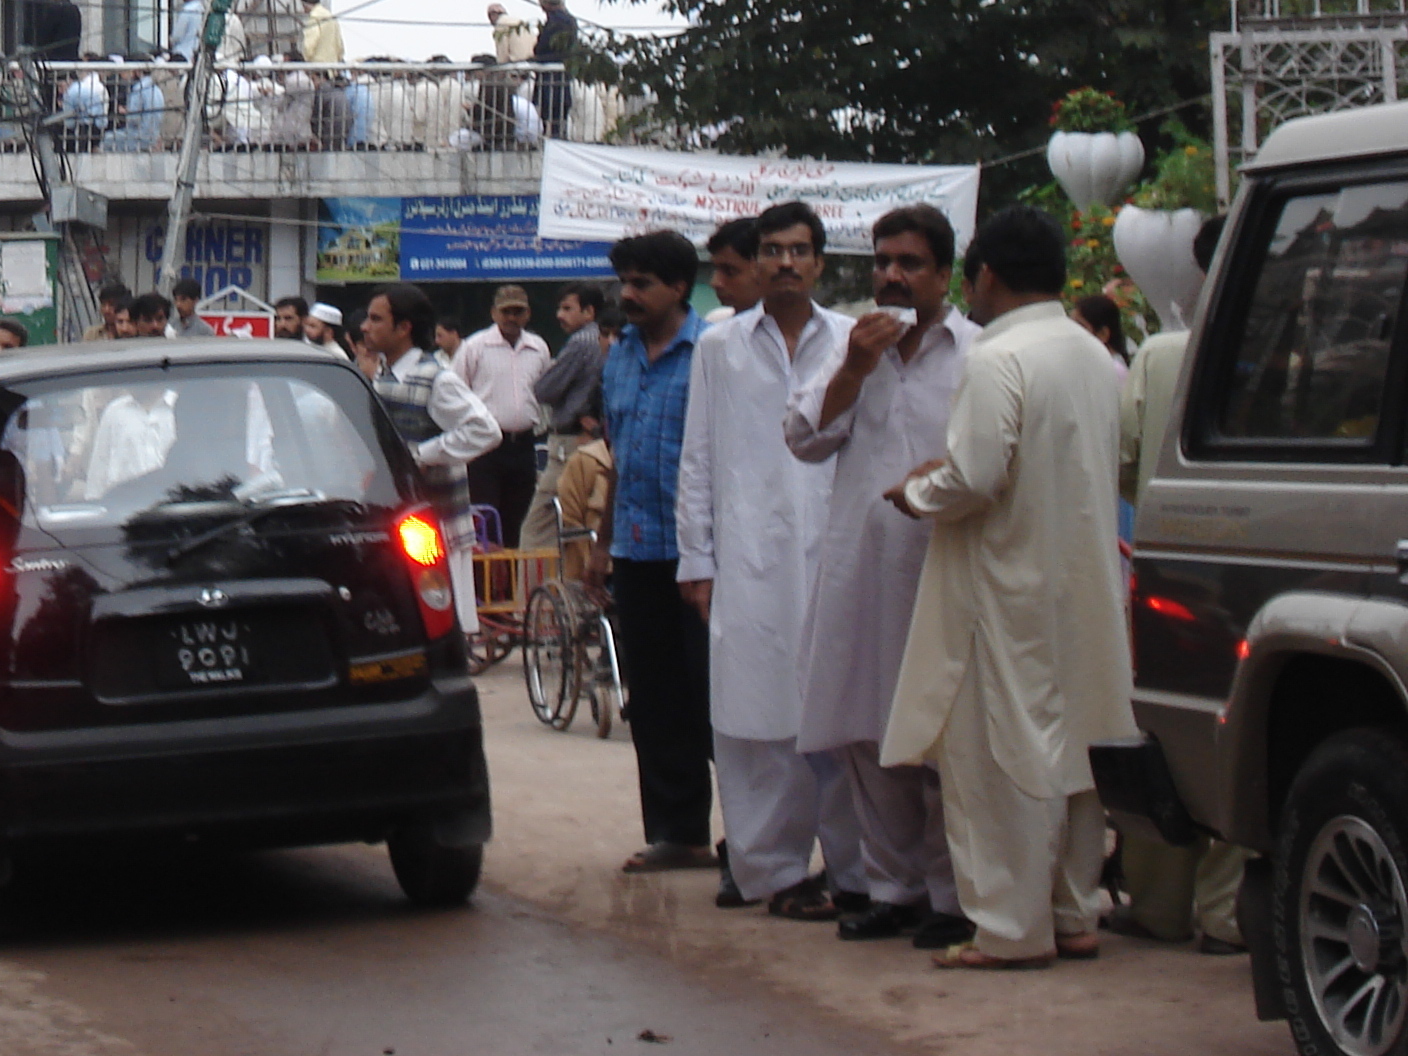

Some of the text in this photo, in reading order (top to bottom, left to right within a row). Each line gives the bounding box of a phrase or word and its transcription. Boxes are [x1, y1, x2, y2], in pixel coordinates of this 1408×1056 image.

[695, 195, 761, 219] MYSTIQUE
[145, 223, 263, 264] CRNER
[155, 265, 253, 302] HOP
